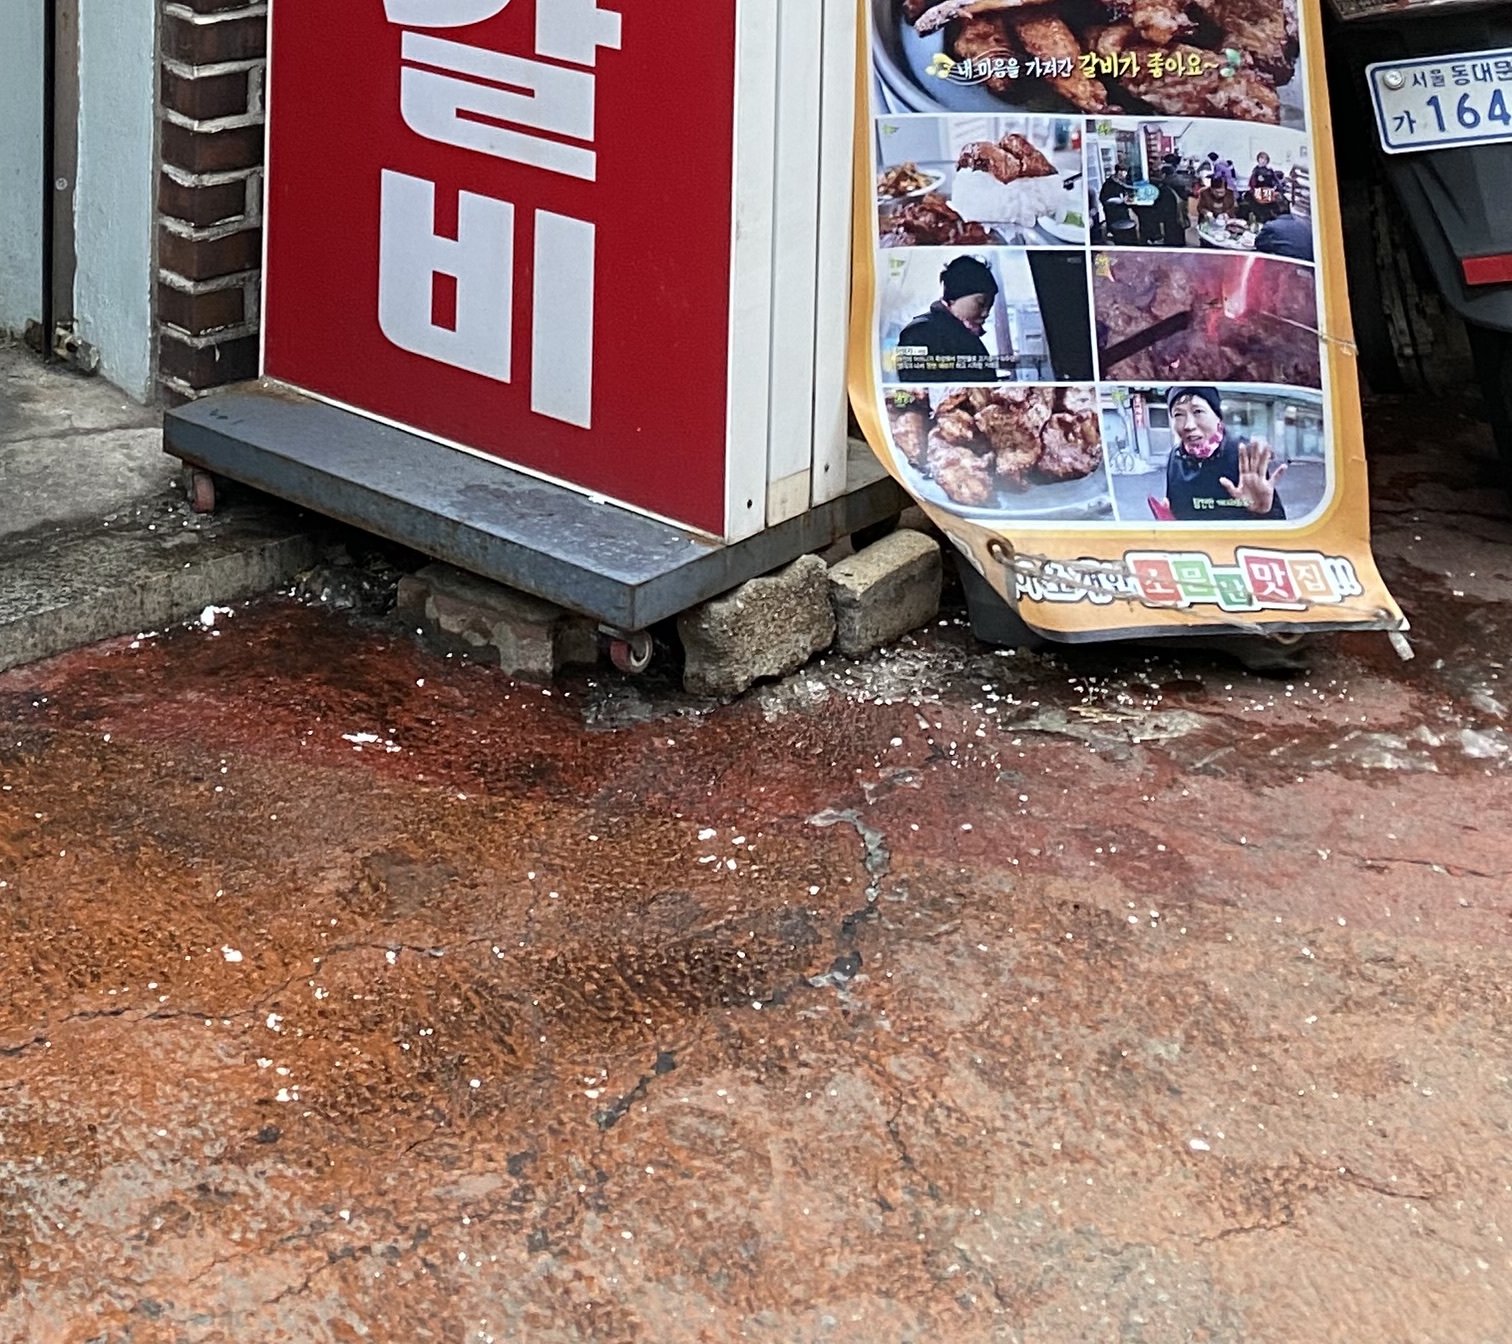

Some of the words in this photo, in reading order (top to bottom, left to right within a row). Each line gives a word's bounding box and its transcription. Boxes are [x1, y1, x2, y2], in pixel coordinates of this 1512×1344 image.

[1078, 51, 1140, 79] 갈비가
[1412, 68, 1446, 88] 서울
[1392, 110, 1417, 134] 가
[1425, 88, 1512, 133] 164
